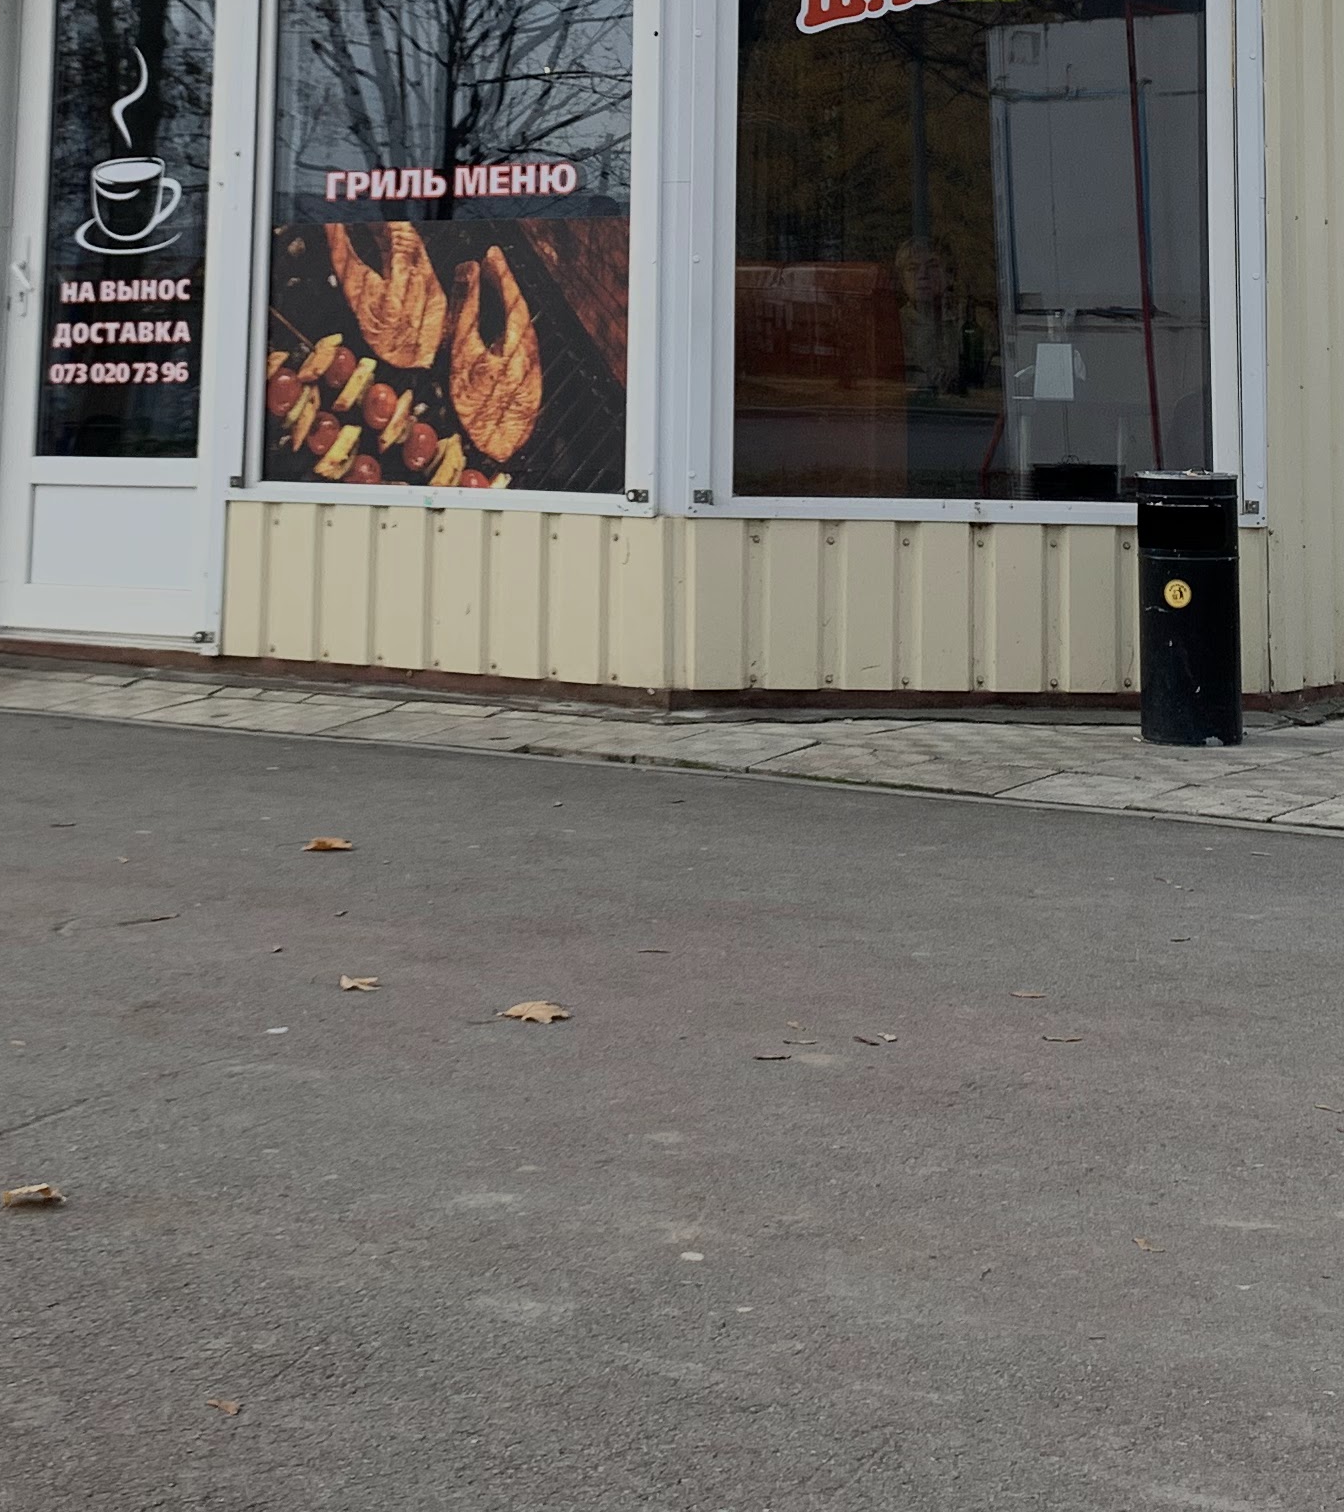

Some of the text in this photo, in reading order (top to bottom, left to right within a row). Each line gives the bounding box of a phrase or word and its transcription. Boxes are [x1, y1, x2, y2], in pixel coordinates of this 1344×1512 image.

[325, 162, 577, 201] ГРИЛЬ МЕНЮ
[60, 279, 192, 302] НА ВЫНОС
[52, 321, 191, 348] ДОСТАВКА
[50, 361, 190, 384] 073 020 73 96
